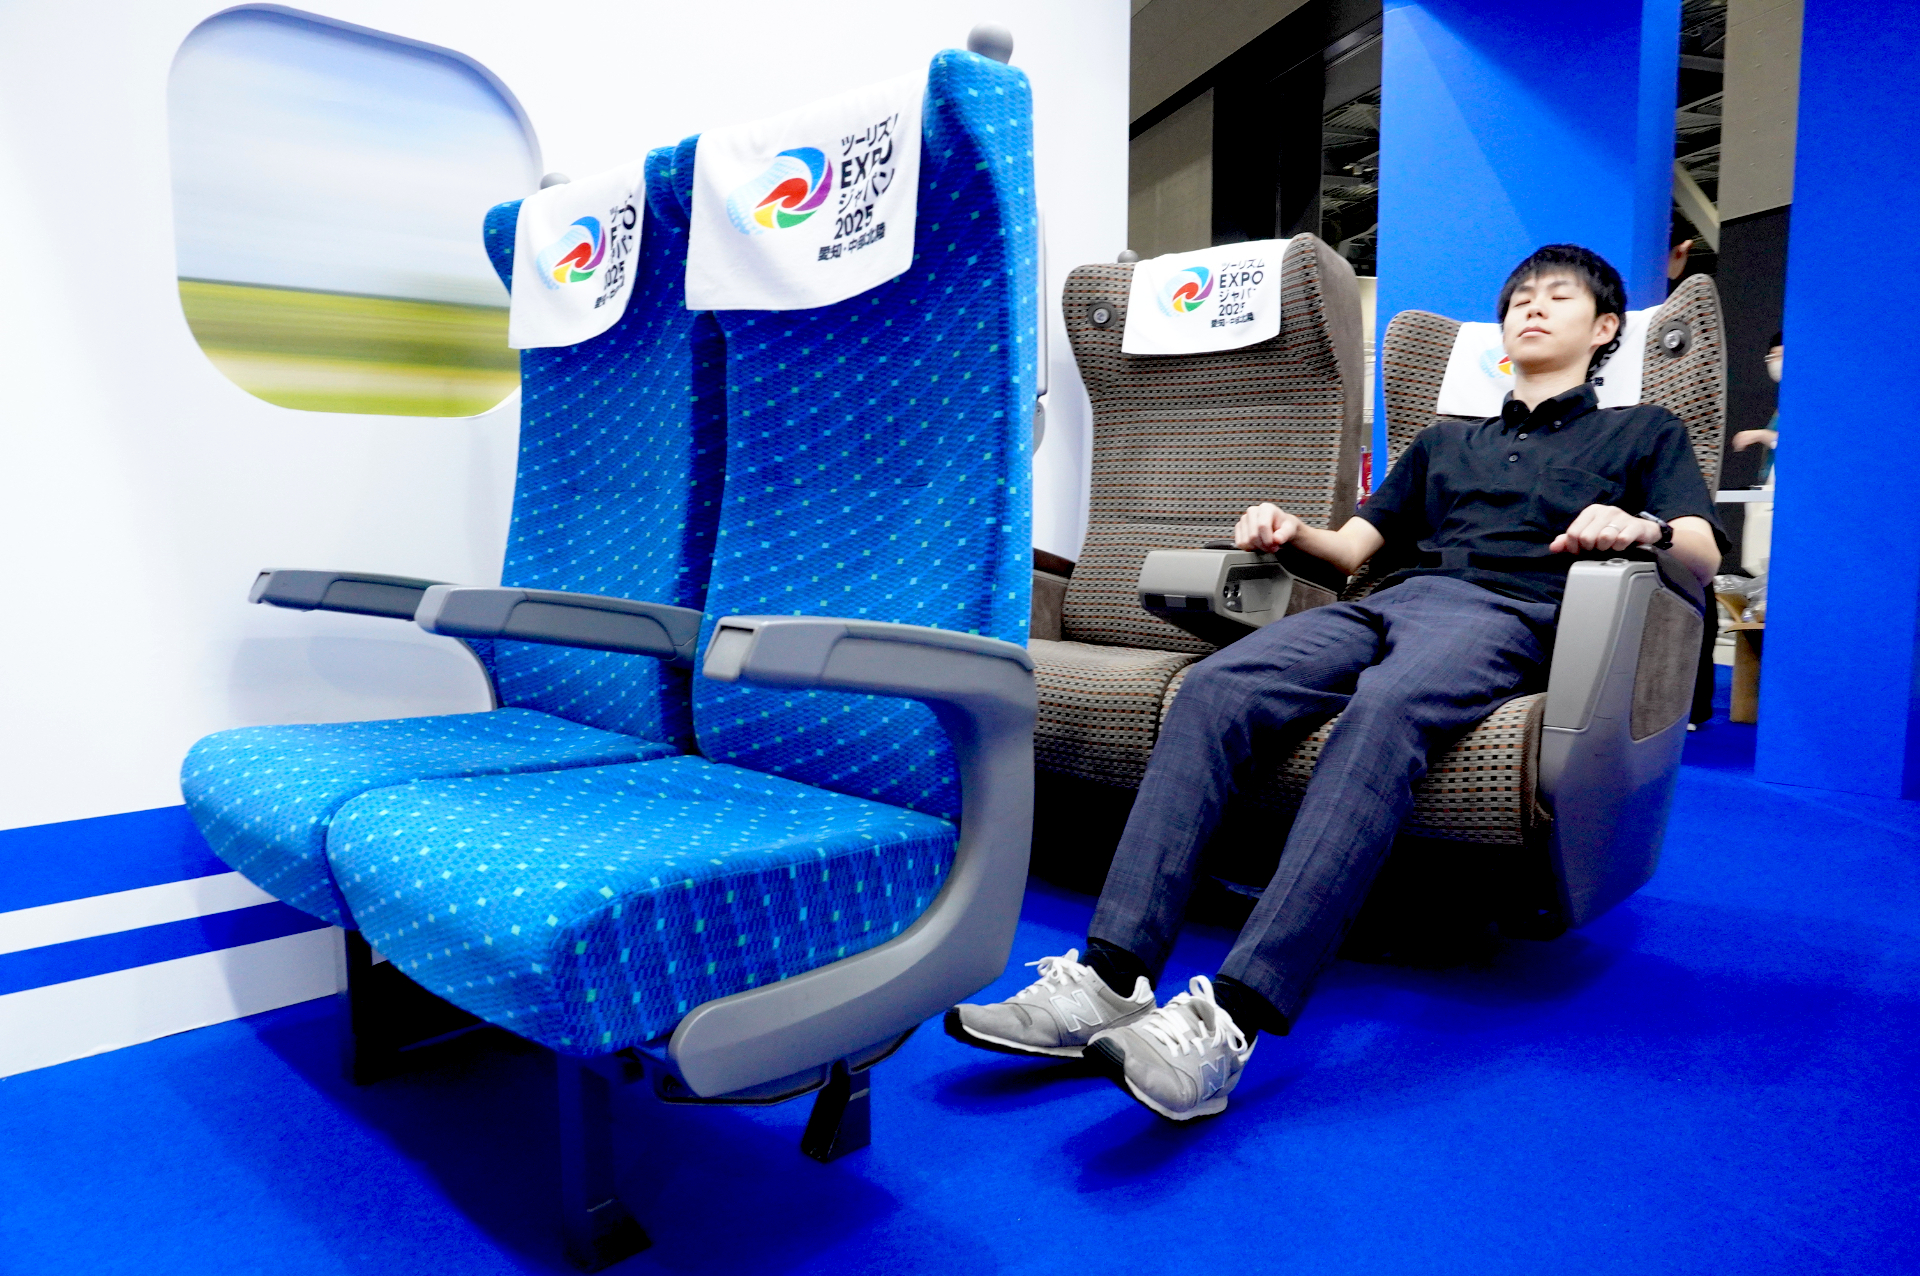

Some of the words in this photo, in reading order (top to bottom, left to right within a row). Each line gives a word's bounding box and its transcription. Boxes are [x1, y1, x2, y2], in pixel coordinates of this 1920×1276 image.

[833, 204, 874, 240] 2025
[1219, 270, 1264, 289] EXPO
[1050, 989, 1103, 1032] N
[1199, 1054, 1226, 1100] N
